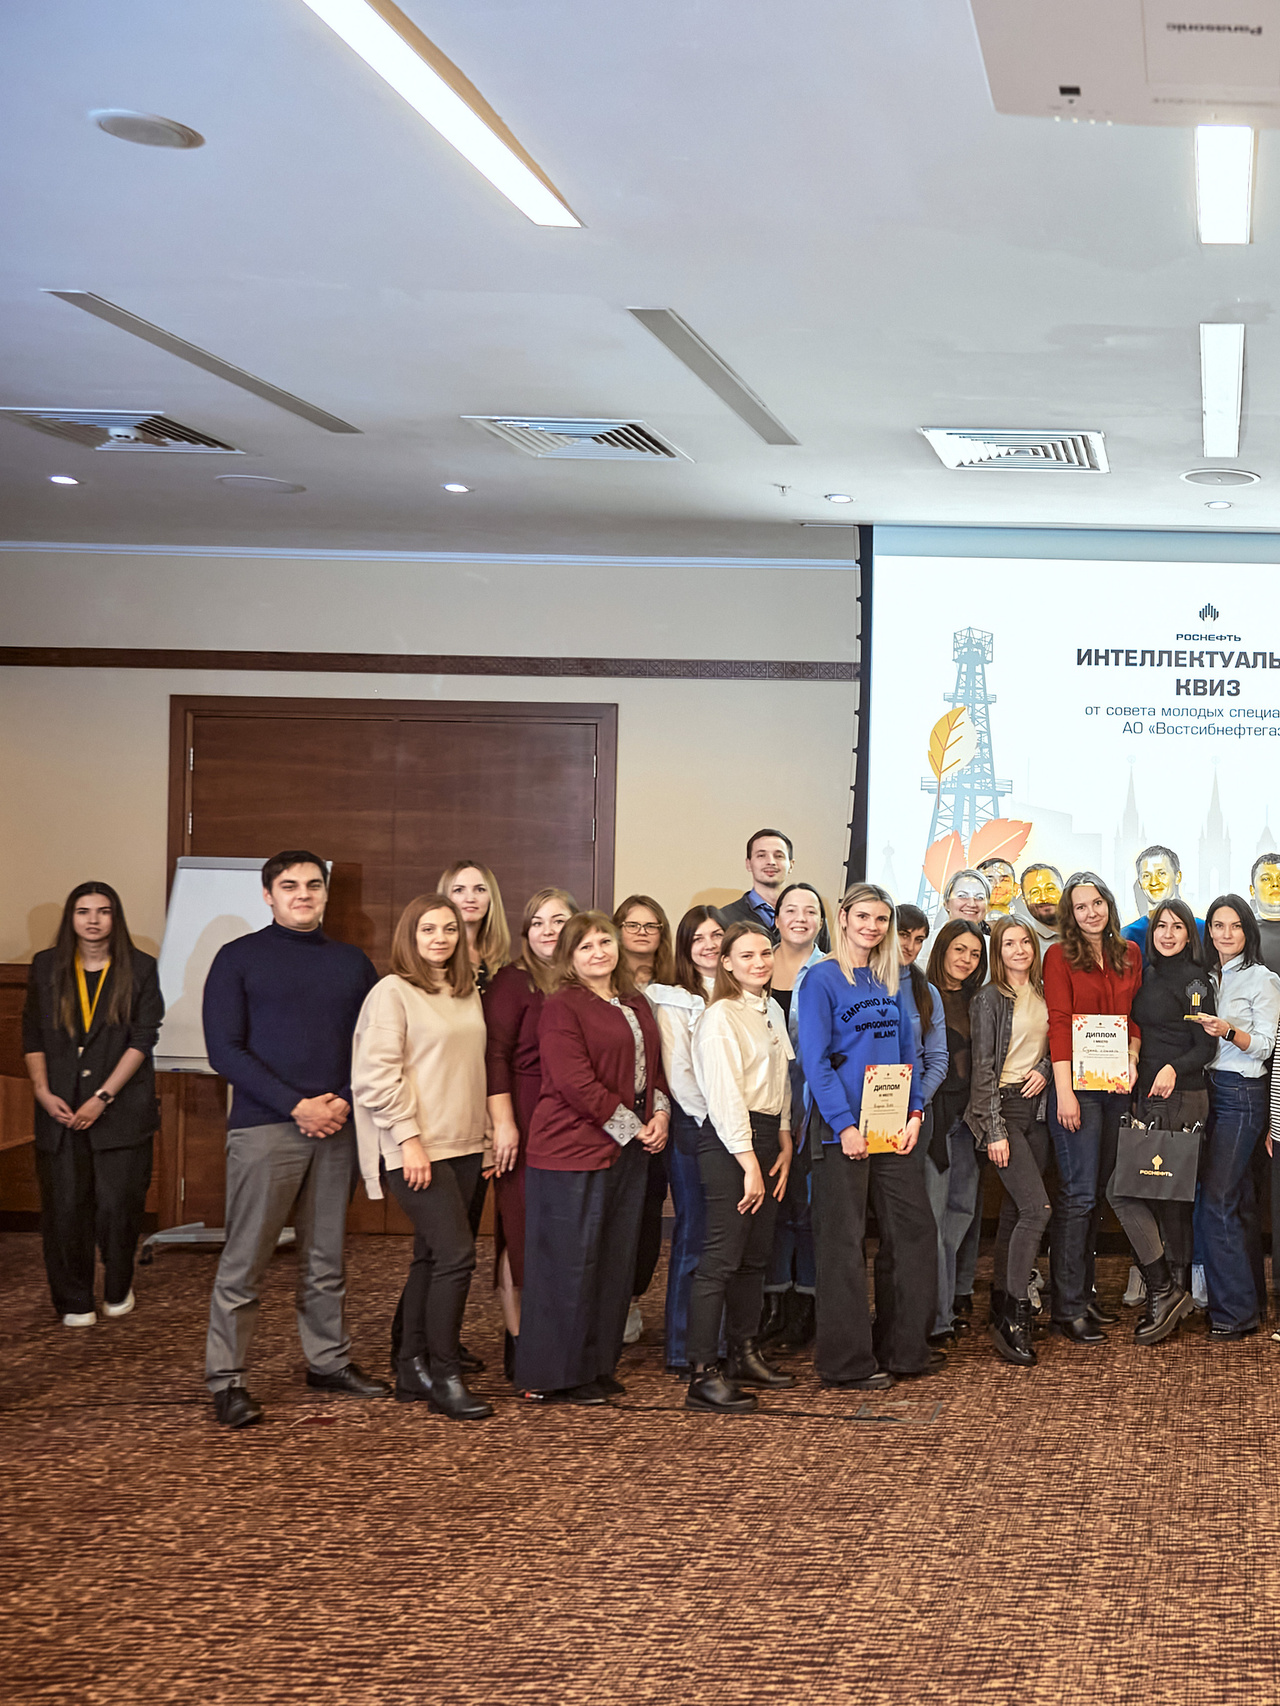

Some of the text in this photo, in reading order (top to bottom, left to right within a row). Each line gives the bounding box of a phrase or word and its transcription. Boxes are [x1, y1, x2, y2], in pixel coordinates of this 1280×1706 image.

[1166, 23, 1263, 36] Panasonic
[1176, 633, 1241, 642] РОСНЕФТЬ
[1175, 678, 1241, 697] КВИЗ
[1085, 705, 1101, 716] от
[1106, 706, 1156, 717] совета
[1161, 707, 1225, 720] молодых
[1122, 721, 1144, 735] АО
[841, 998, 880, 1023] EMPORIO
[873, 1084, 900, 1092] ДИПЛОМ
